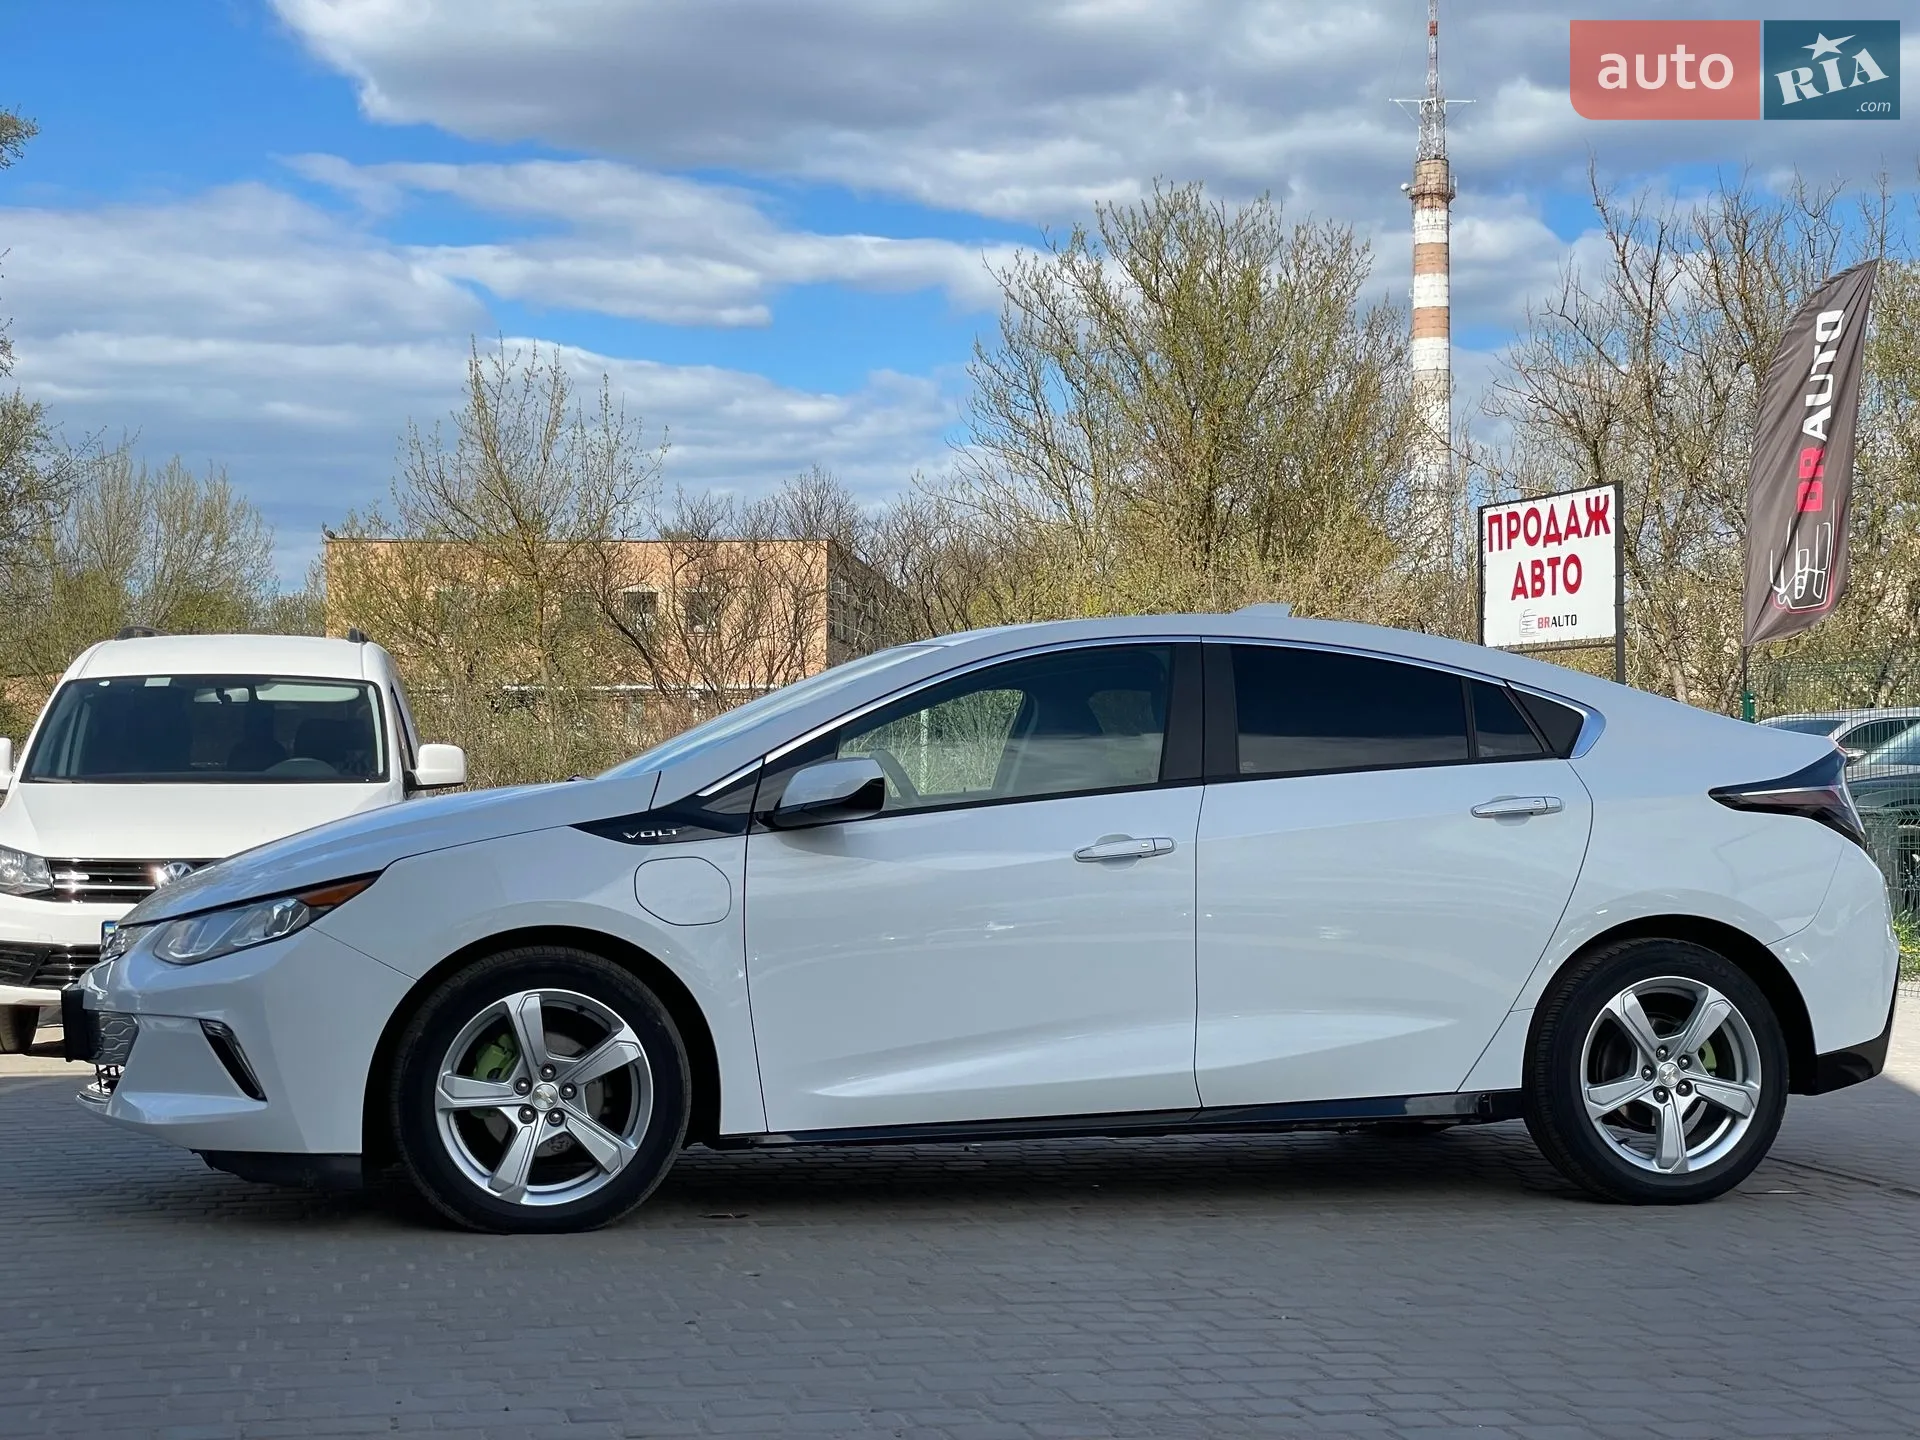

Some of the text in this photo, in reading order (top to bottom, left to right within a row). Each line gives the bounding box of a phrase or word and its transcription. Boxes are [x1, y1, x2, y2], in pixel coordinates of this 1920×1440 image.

[1487, 495, 1611, 553] ПРОДАЖ
[1511, 553, 1583, 601] АВТО
[622, 828, 681, 839] VOLT
